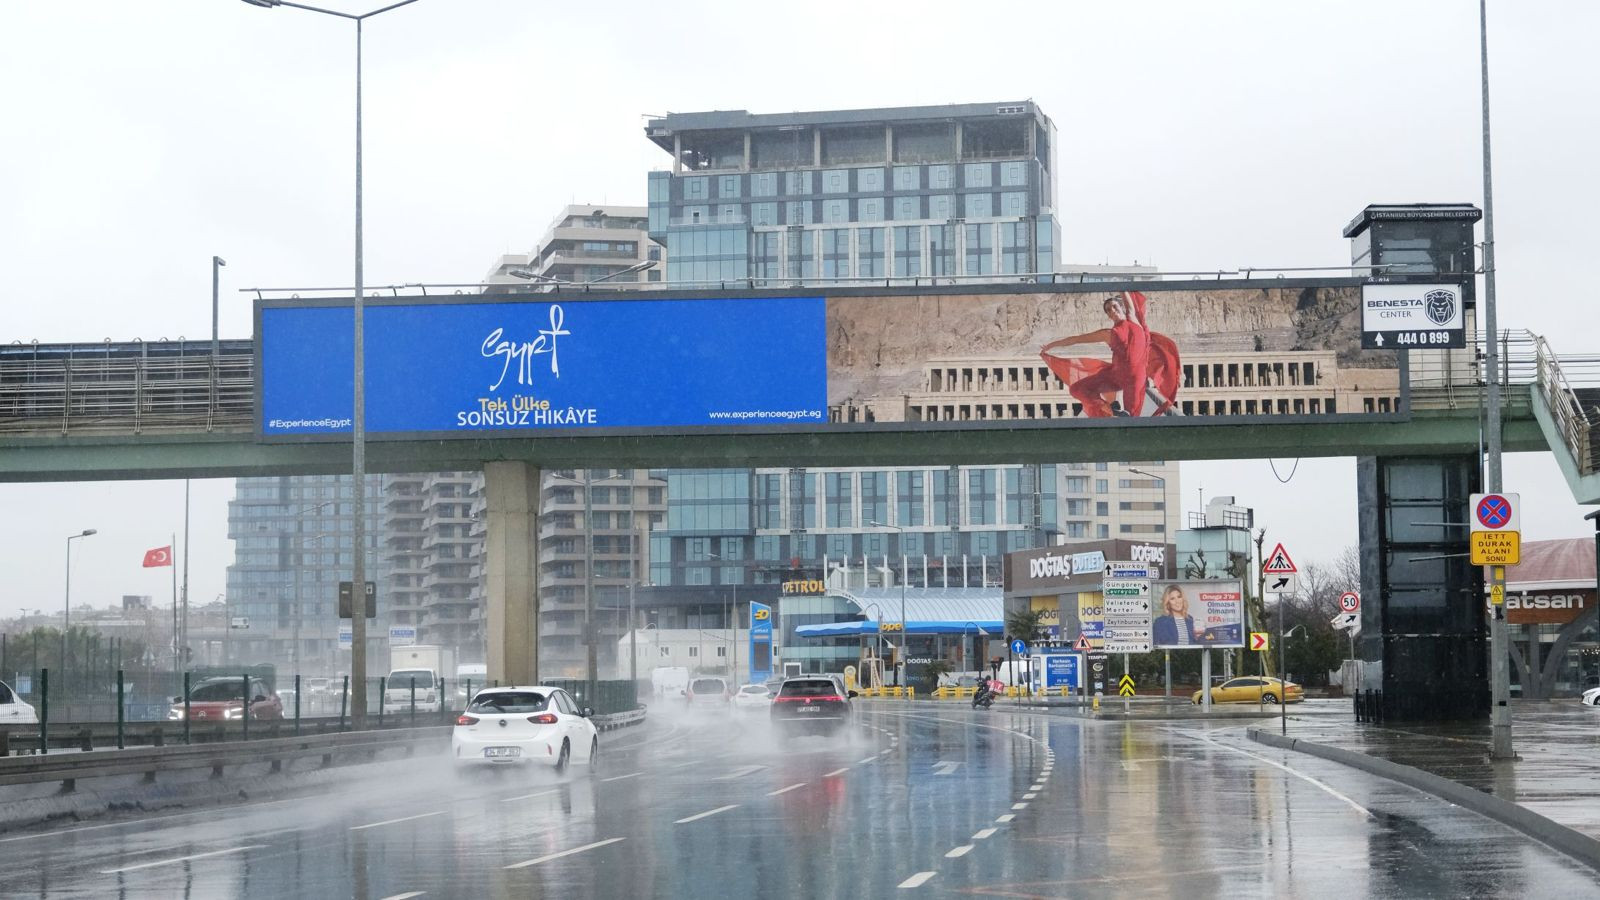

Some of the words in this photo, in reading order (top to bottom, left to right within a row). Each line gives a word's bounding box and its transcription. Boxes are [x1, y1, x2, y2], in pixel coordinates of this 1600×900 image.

[1397, 332, 1417, 344] 444
[1420, 332, 1427, 344] 0
[1429, 331, 1450, 343] 899
[478, 398, 508, 411] Tek
[512, 395, 550, 411] Ülke
[457, 411, 530, 426] SONSUZ
[709, 410, 821, 419] www.experienceegypt.eg
[268, 419, 352, 428] #ExperienceEgypt
[1131, 543, 1164, 566] DOĞTAŞ
[1030, 552, 1071, 580] DOĞTAŞ
[782, 580, 826, 592] PETROL
[1344, 598, 1356, 607] 50
[880, 623, 903, 631] ope
